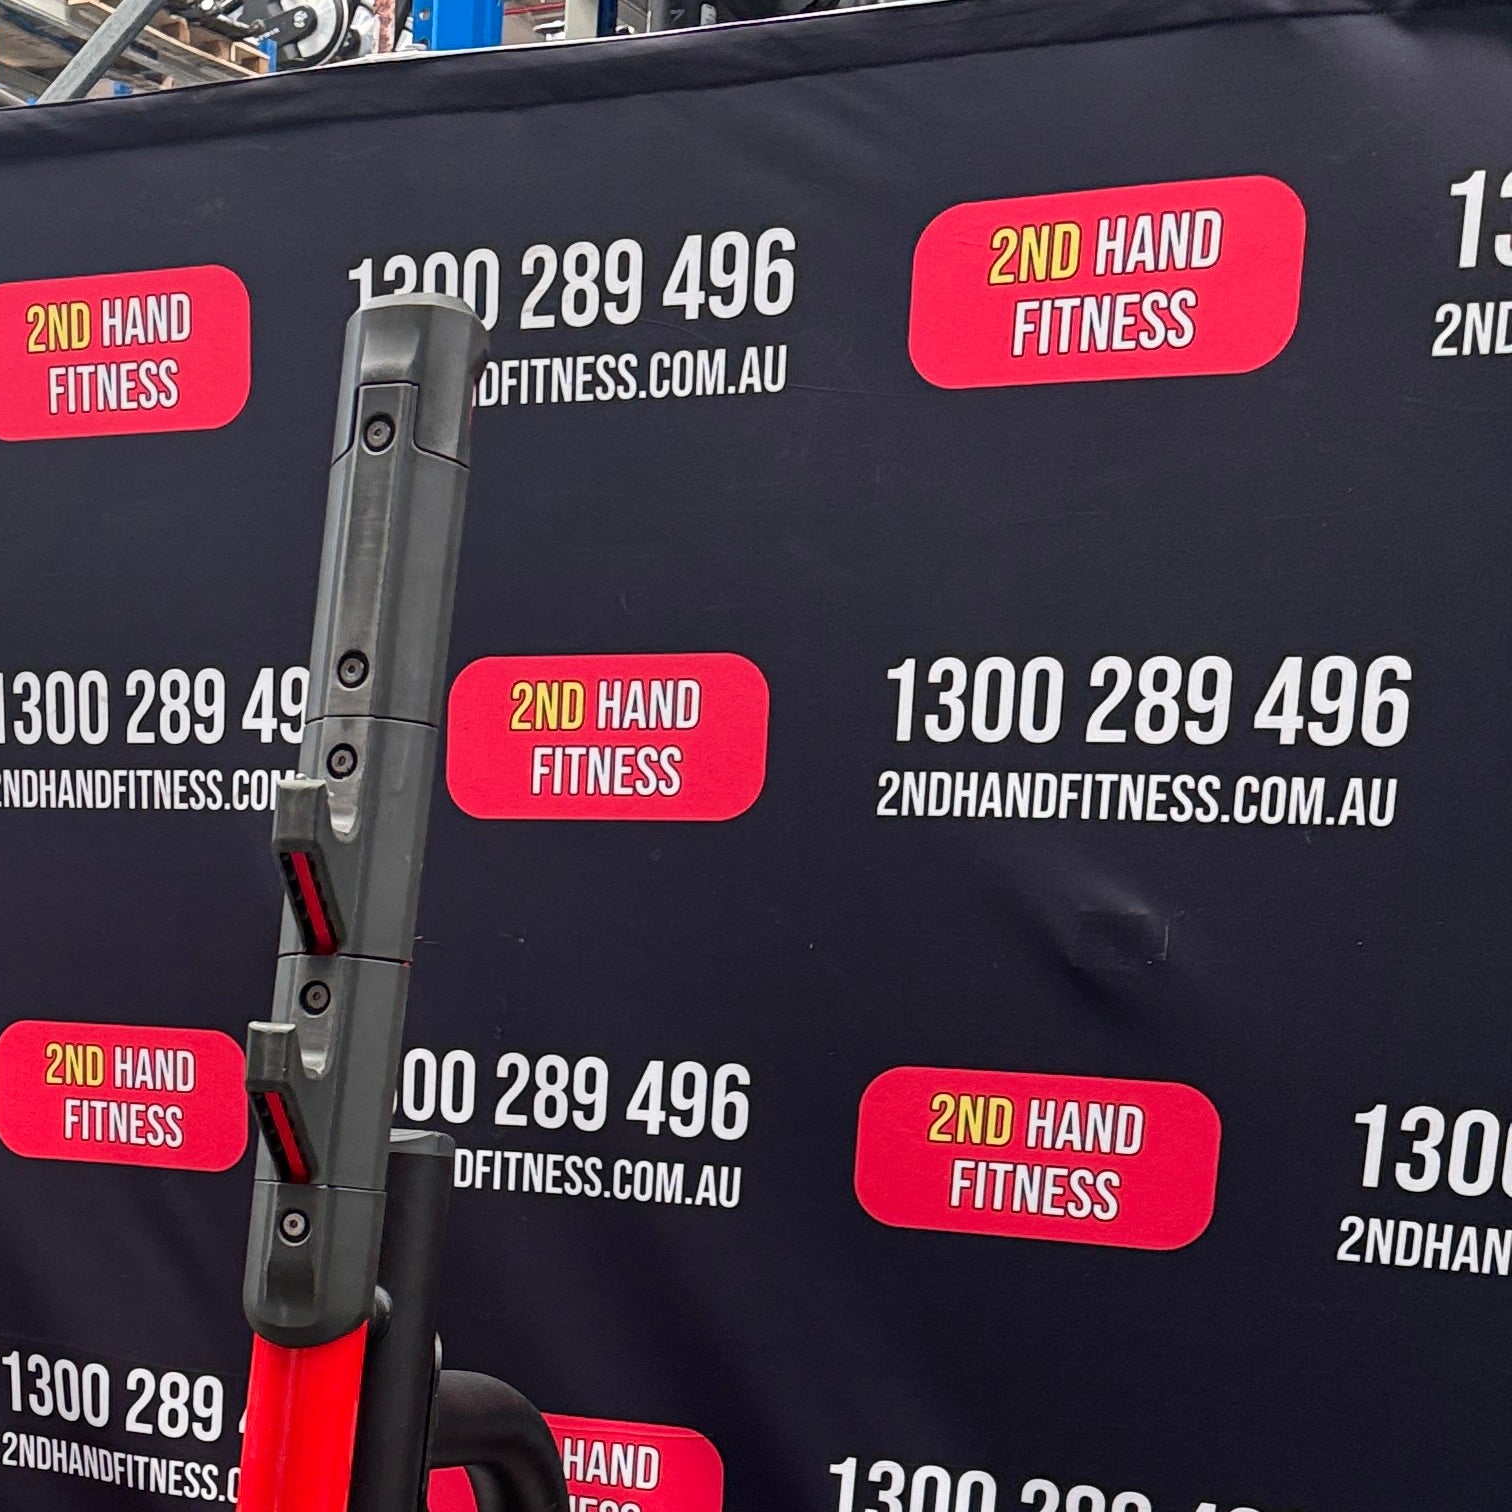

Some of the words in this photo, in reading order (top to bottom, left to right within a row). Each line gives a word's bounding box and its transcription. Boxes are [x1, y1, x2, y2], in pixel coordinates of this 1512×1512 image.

[989, 223, 1081, 284] 2ND
[1095, 210, 1222, 275] HAND
[519, 238, 643, 330] 289
[662, 227, 796, 321] 496
[27, 302, 91, 353] 2ND
[102, 293, 191, 347] HAND
[1012, 289, 1197, 356] FITNESS
[49, 359, 178, 414] FITNESS
[125, 667, 226, 745] 289
[243, 666, 310, 744] 49
[511, 681, 585, 730] 2ND
[597, 679, 700, 729] HAND
[887, 656, 1064, 744] 1300
[1085, 655, 1233, 745] 289
[1253, 655, 1413, 748] 496
[532, 746, 682, 796] FITNESS
[876, 770, 1398, 827] 2NDHANDFITNESS.COM.AU
[46, 1043, 104, 1086] 2ND
[114, 1046, 195, 1092] HAND
[393, 1048, 476, 1123] 00
[494, 1052, 609, 1132] 289
[625, 1060, 751, 1141] 496
[65, 1098, 183, 1148] FITNESS
[929, 1093, 1013, 1146] 2ND
[1026, 1099, 1144, 1155] HAND
[1355, 1104, 1512, 1198] 130
[454, 1148, 742, 1208] DFITNESS.COM.AU
[950, 1159, 1120, 1221] FITNESS
[1337, 1215, 1512, 1276] 2NDHAN
[1, 1350, 110, 1428] 1300
[125, 1367, 224, 1442] 289
[563, 1437, 660, 1490] HAND
